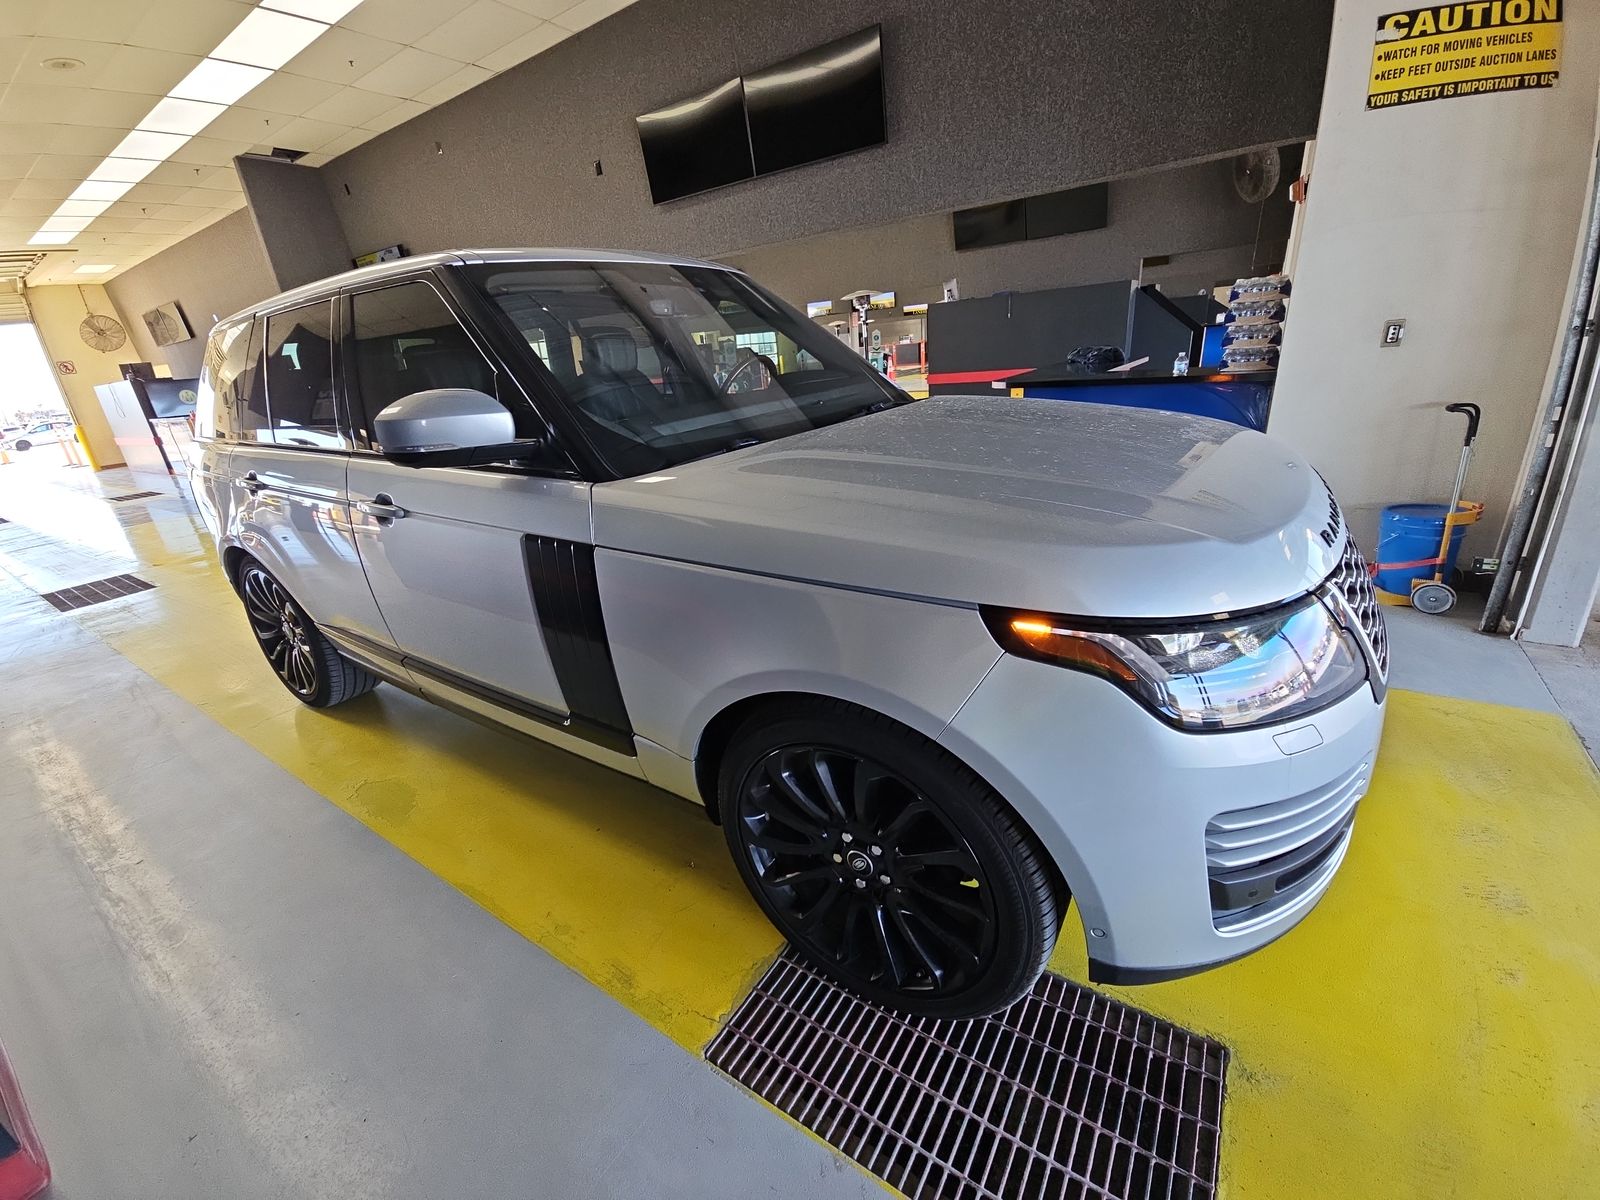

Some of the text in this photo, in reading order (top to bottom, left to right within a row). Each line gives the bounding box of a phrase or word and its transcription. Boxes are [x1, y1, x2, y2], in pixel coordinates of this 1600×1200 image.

[1384, 0, 1557, 40] CAUTION
[1383, 31, 1533, 62] WATCH FOR MOVING VEHICLES
[1380, 48, 1557, 81] KEEP FEET OUTSIDE AUCTION LANES
[1370, 73, 1555, 107] YOUR SAFETY IS IMPORTANT TO US
